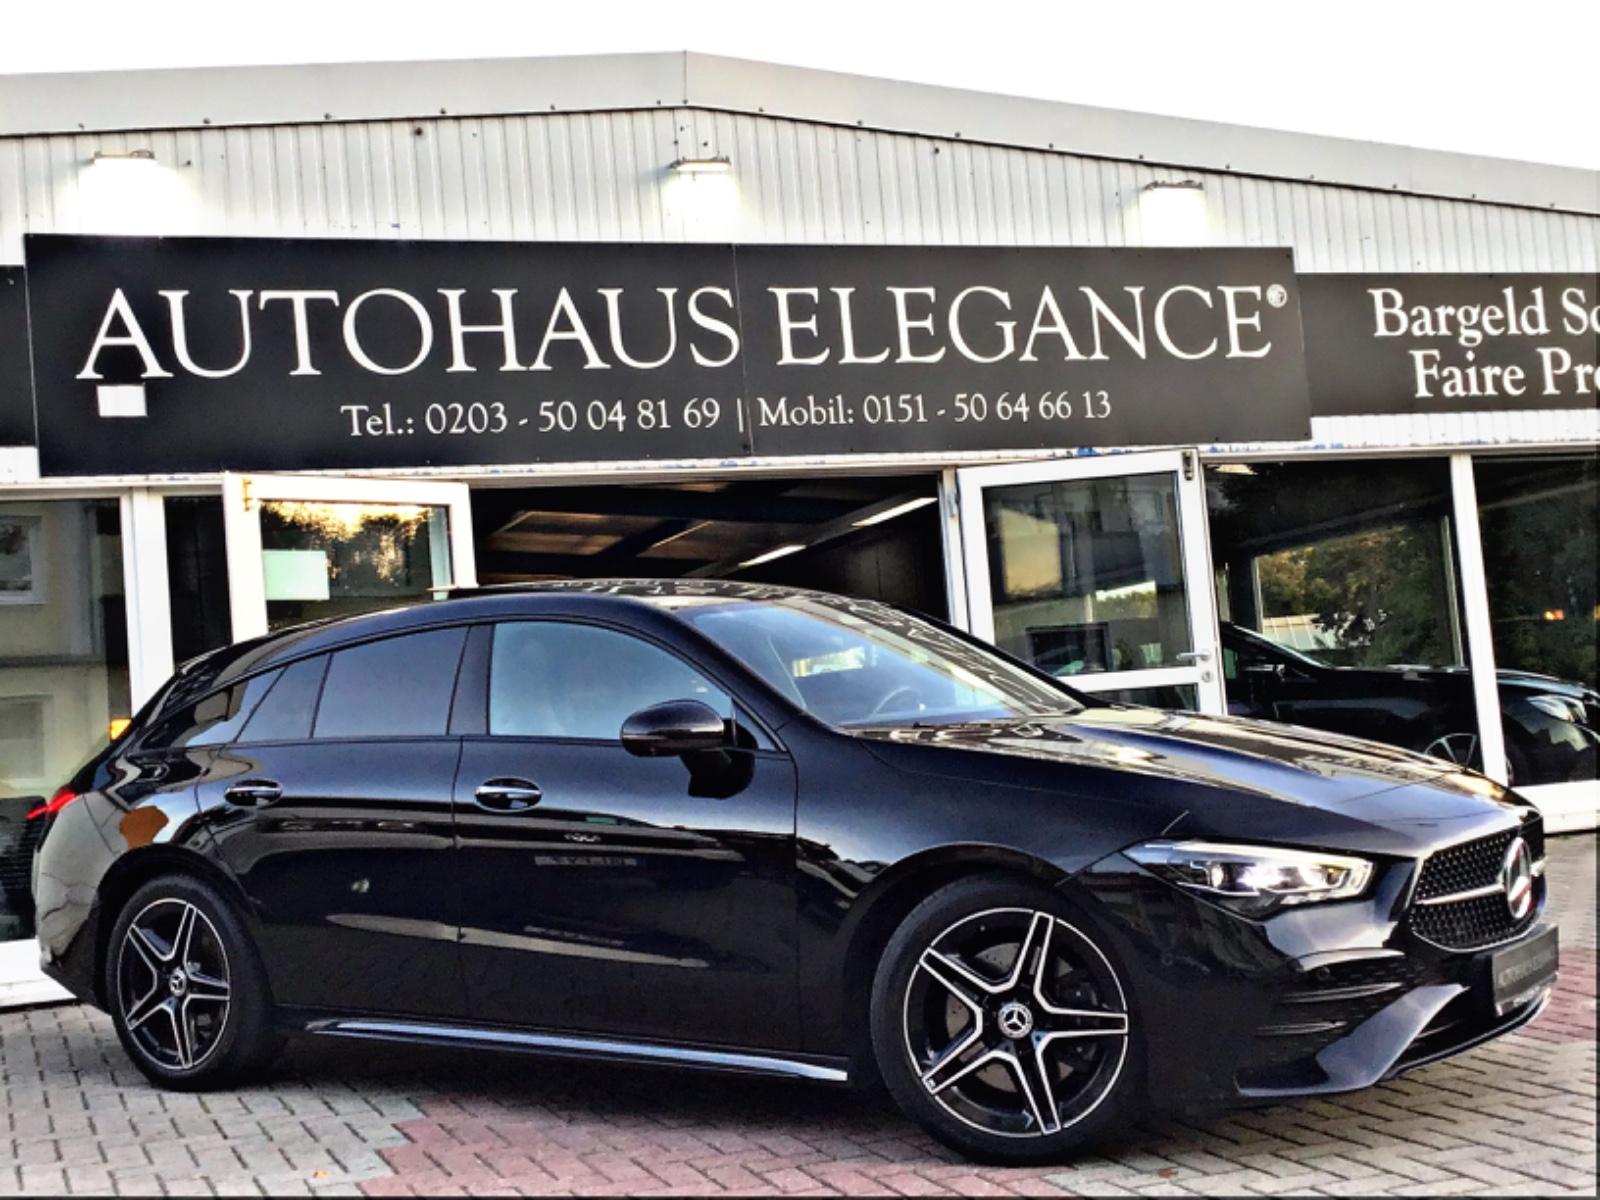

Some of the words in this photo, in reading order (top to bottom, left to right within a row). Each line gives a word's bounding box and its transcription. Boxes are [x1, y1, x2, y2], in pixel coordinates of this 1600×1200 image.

[75, 286, 740, 380] AUTOHAUS
[1367, 286, 1551, 347] Bargeld
[1408, 348, 1527, 398] Faire
[340, 403, 415, 437] Tel.:
[425, 401, 508, 434] 0203
[539, 400, 578, 433] 50
[586, 399, 627, 433] 04
[637, 399, 672, 430] 81
[683, 397, 721, 429] 69
[757, 393, 854, 427] Mobil:
[863, 393, 929, 424] 0151
[954, 392, 988, 423] 50
[995, 391, 1032, 423] 64
[1038, 390, 1073, 421] 66
[1081, 389, 1112, 420] 13
